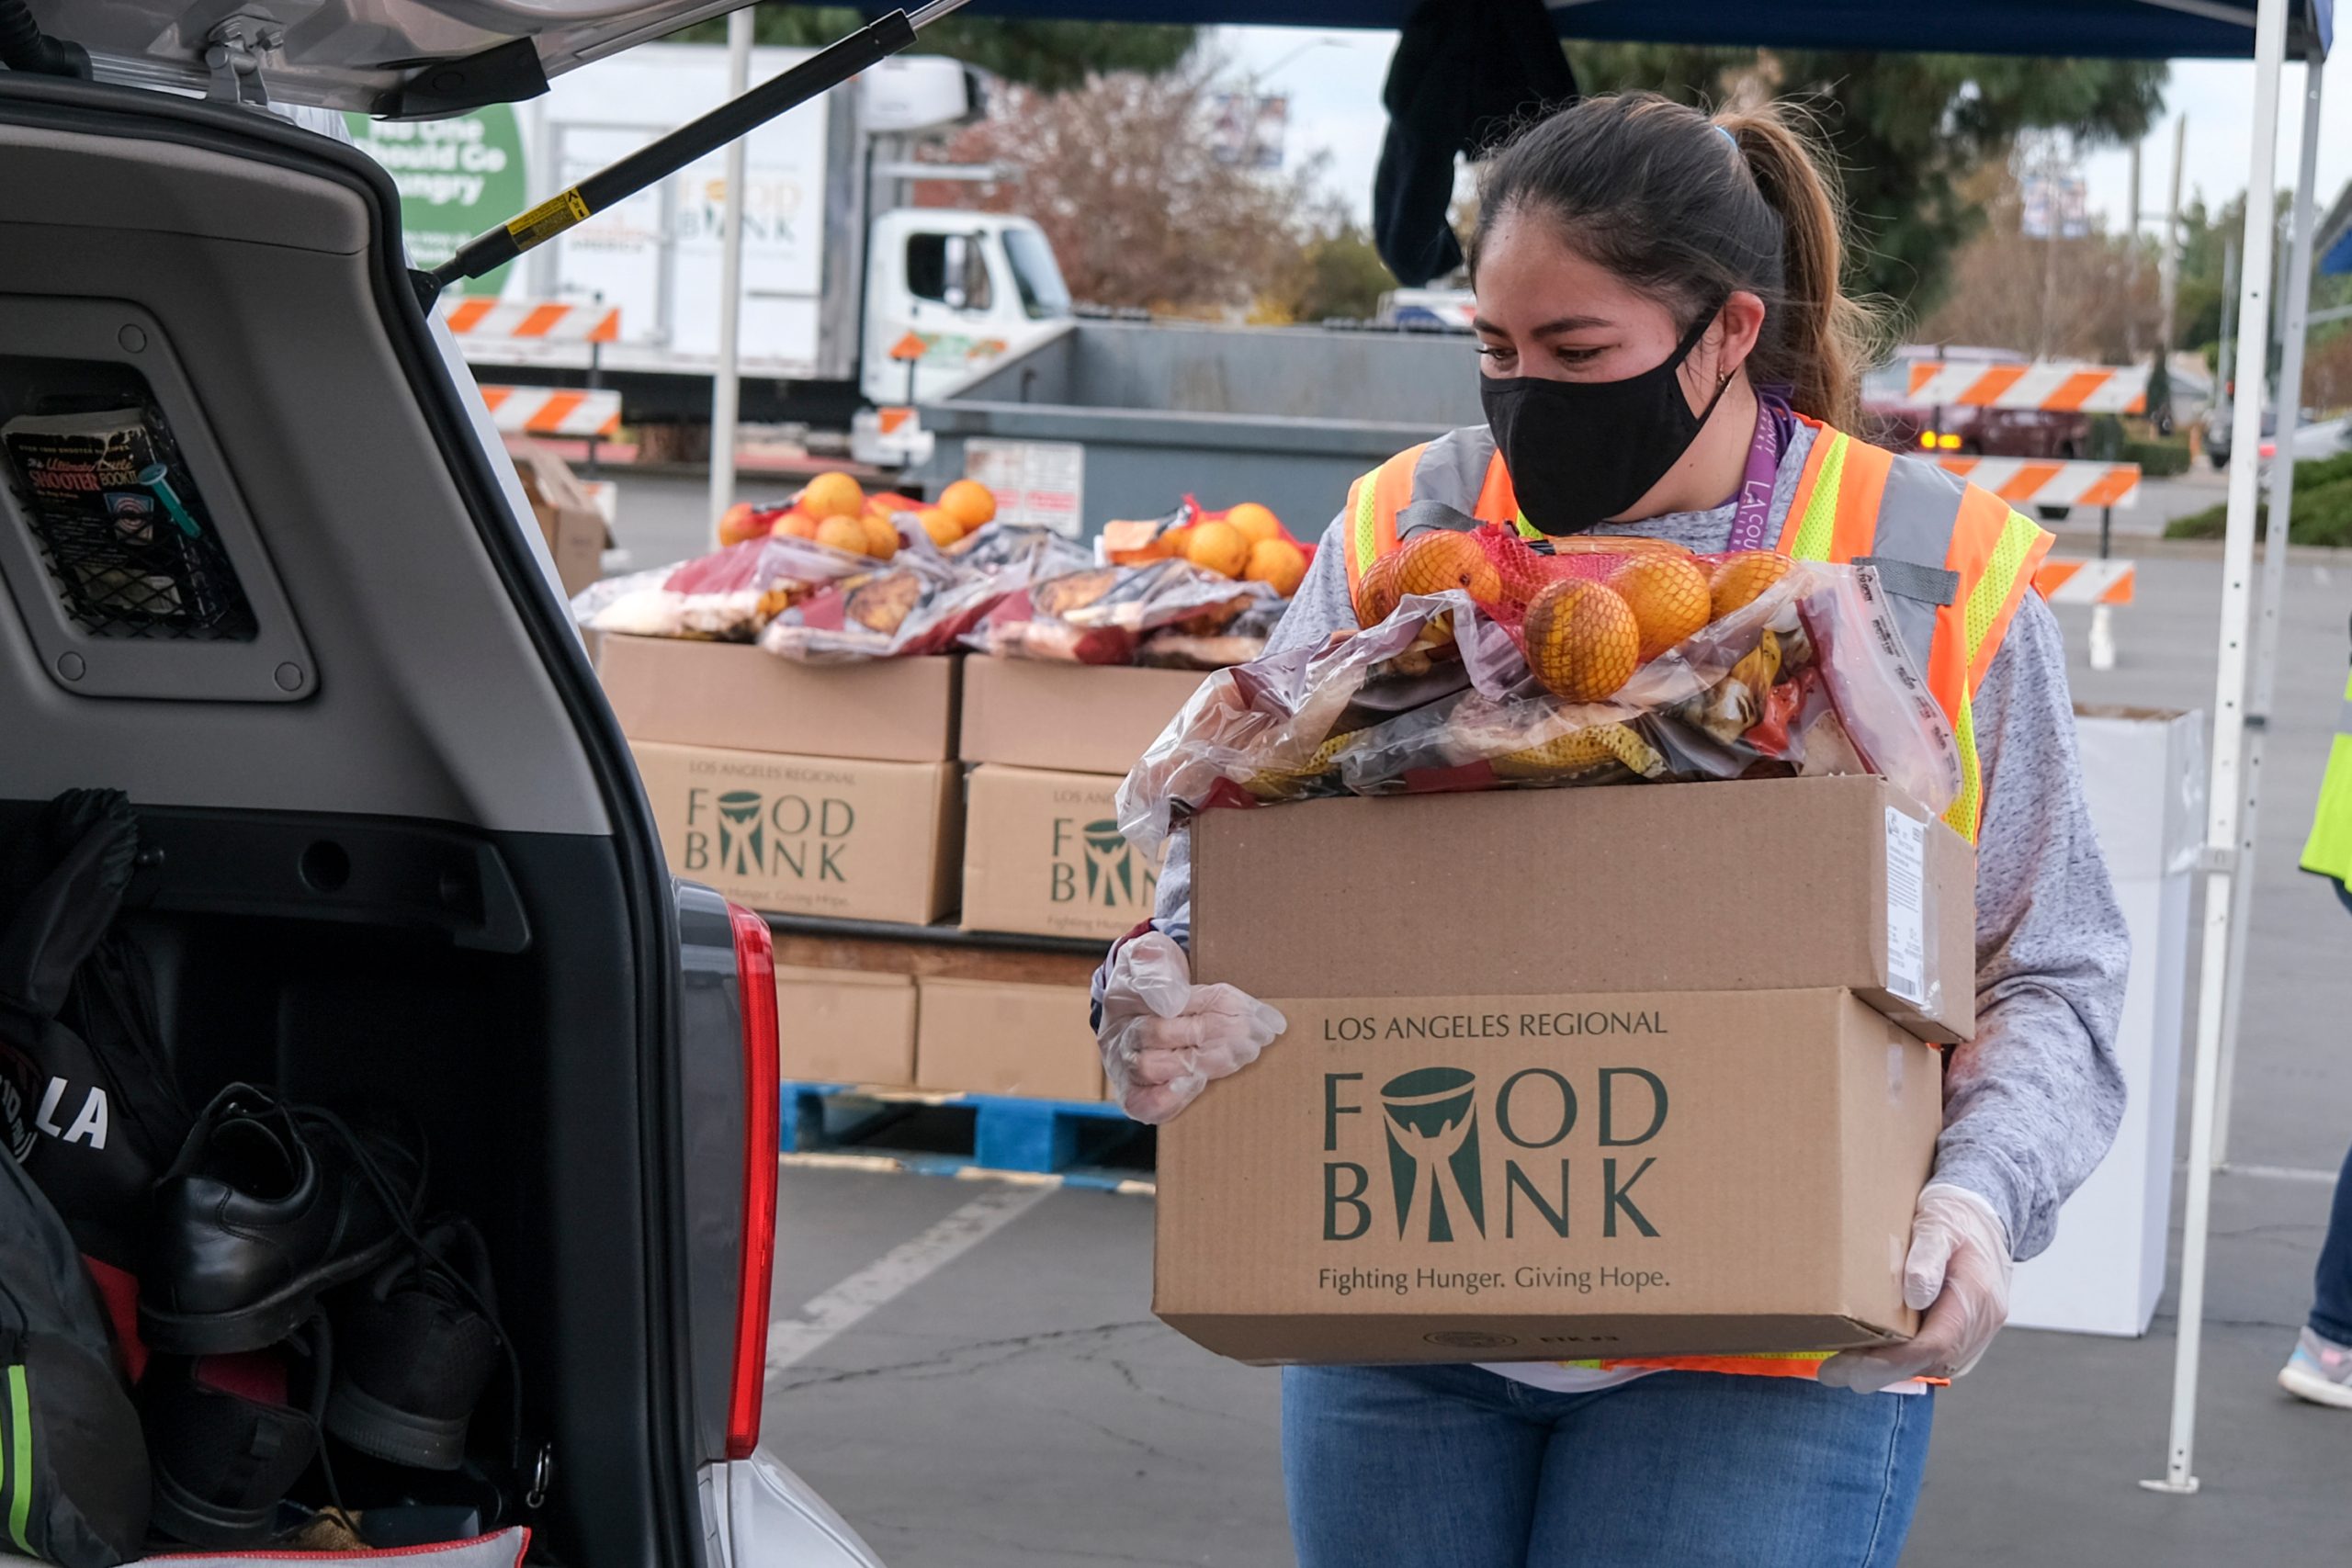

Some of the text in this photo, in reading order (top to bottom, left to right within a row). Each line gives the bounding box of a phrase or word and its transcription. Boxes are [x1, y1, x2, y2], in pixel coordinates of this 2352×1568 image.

[460, 143, 507, 173] Go
[398, 173, 485, 206] ungry
[46, 456, 96, 472] Ultimate
[28, 470, 101, 491] SHOOTER
[690, 761, 856, 785] LOS ANGELES REGIONAL
[687, 787, 854, 838] FOOD
[684, 830, 846, 882] BANK
[1324, 1011, 1668, 1041] LOS ANGELES REGIONAL
[35, 1076, 109, 1150] LA
[1324, 1066, 1668, 1151] FOOD
[1323, 1157, 1661, 1242] BANK
[1318, 1266, 1670, 1295] Fighting Hunger. Giving Hope.
